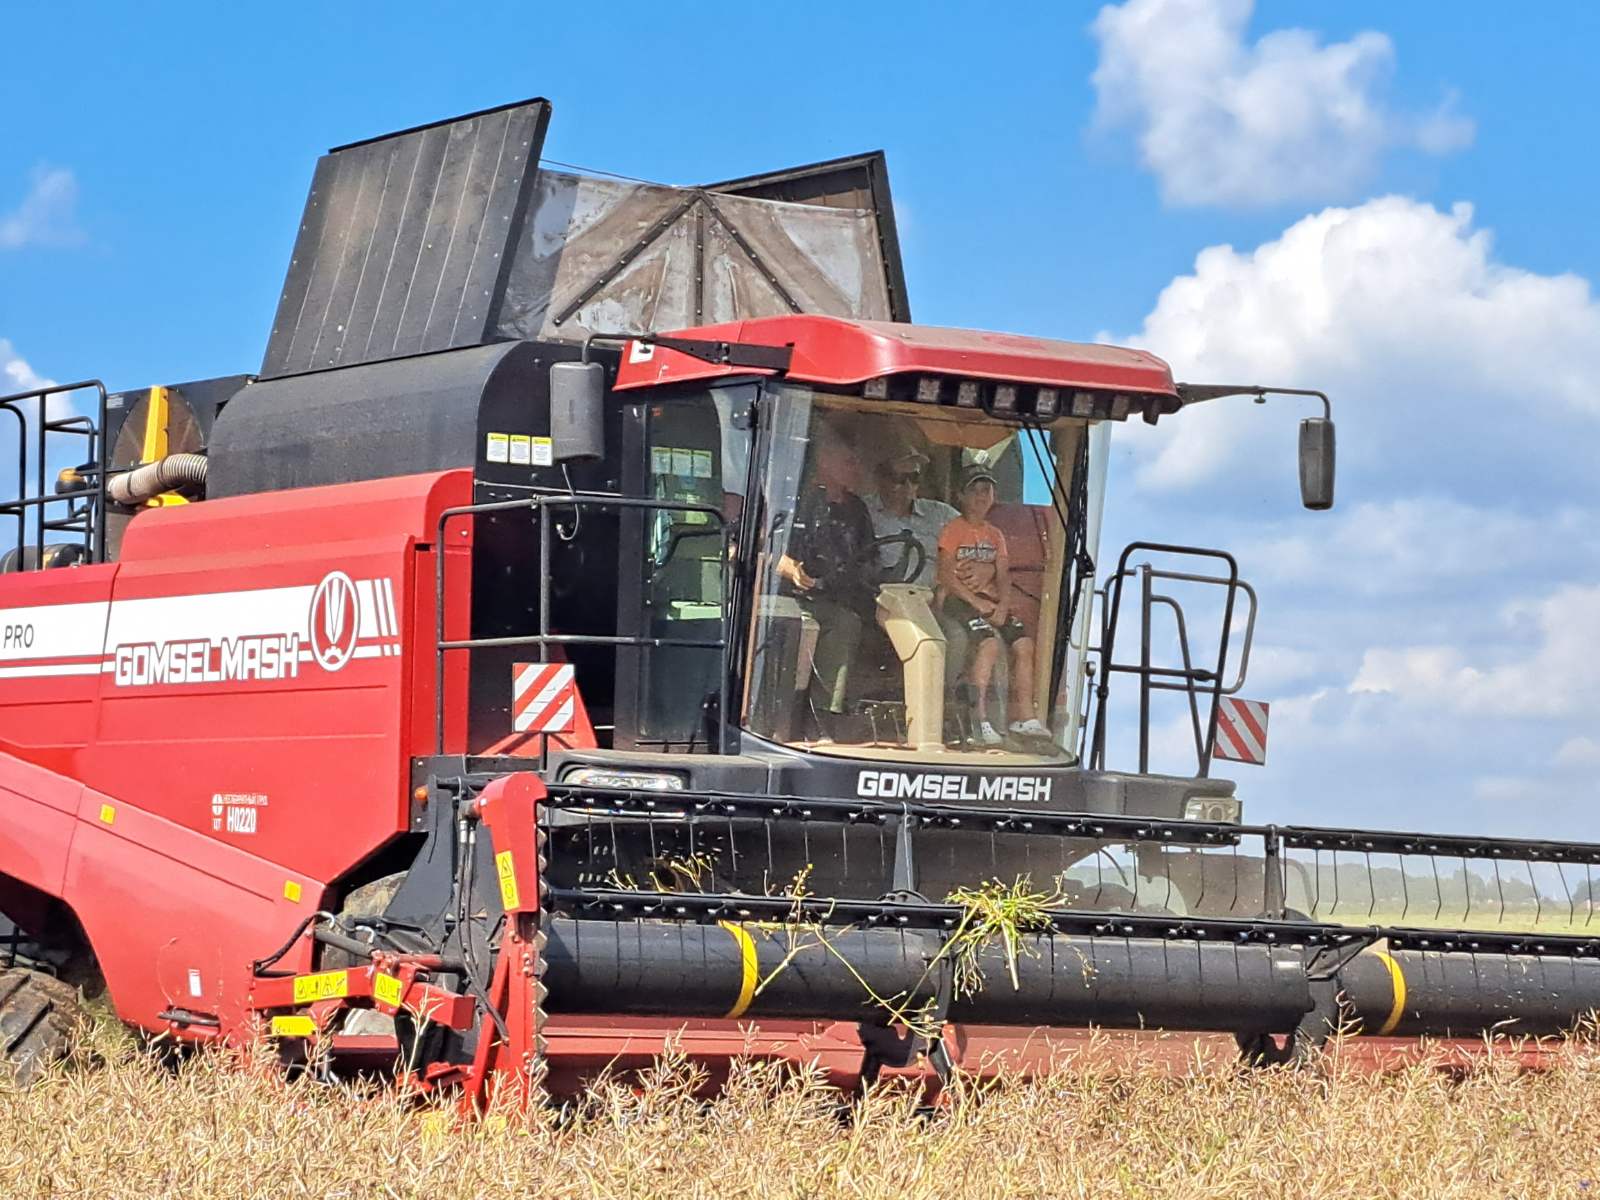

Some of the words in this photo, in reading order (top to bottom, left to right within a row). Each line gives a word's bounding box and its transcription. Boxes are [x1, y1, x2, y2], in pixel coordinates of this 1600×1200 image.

[3, 623, 35, 649] PRO
[115, 632, 299, 687] GOMSELMASH
[857, 770, 1052, 801] GOMSELMASH
